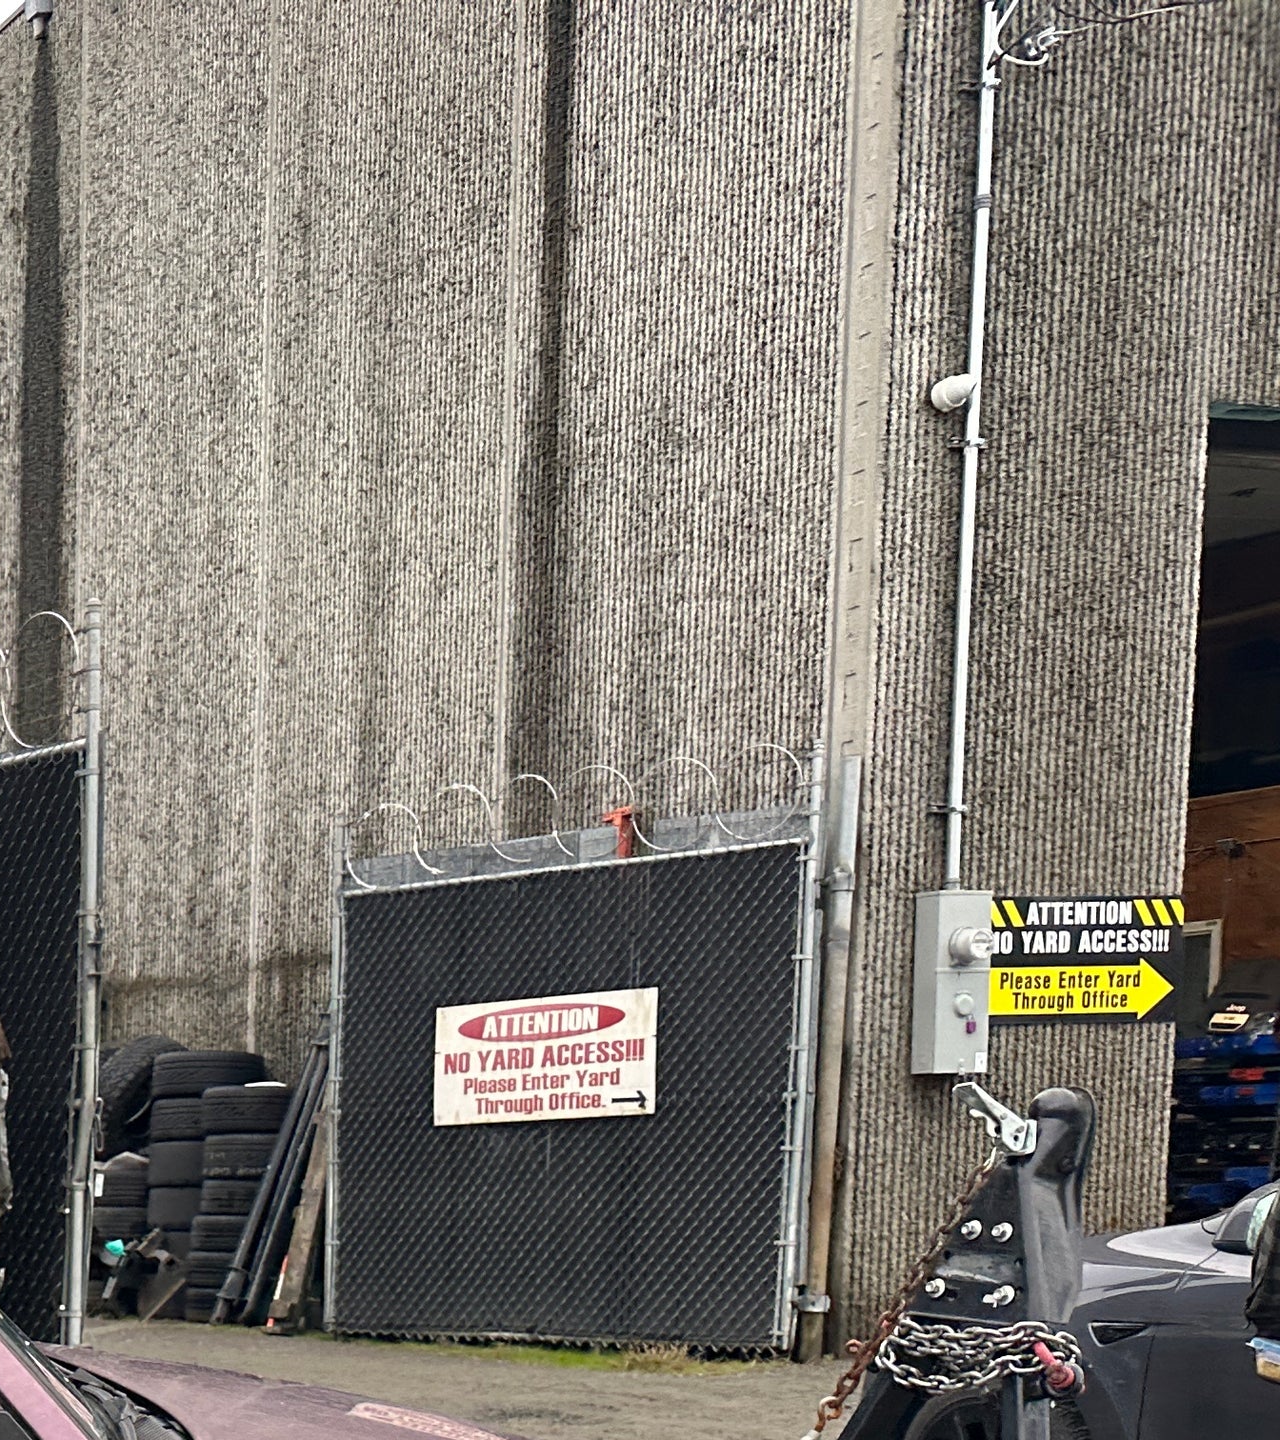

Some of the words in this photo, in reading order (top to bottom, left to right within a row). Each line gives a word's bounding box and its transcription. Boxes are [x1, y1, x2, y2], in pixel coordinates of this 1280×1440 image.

[1026, 900, 1133, 926] ATTENTION
[1021, 930, 1071, 954] YARD
[1078, 929, 1170, 953] ACCESS!!!
[1000, 972, 1051, 990] Please
[1058, 971, 1100, 989] Enter
[1108, 970, 1141, 988] Yard
[1012, 992, 1074, 1012] Through
[1081, 990, 1128, 1008] Office
[481, 1005, 600, 1039] ATTENTION
[443, 1051, 471, 1075] NO
[478, 1047, 535, 1073] YARD
[541, 1038, 646, 1069] ACCESS!!!
[463, 1077, 517, 1095] Please
[522, 1072, 570, 1091] Enter
[576, 1068, 621, 1087] Yard
[475, 1096, 544, 1116] Through
[548, 1093, 607, 1112] Office.
